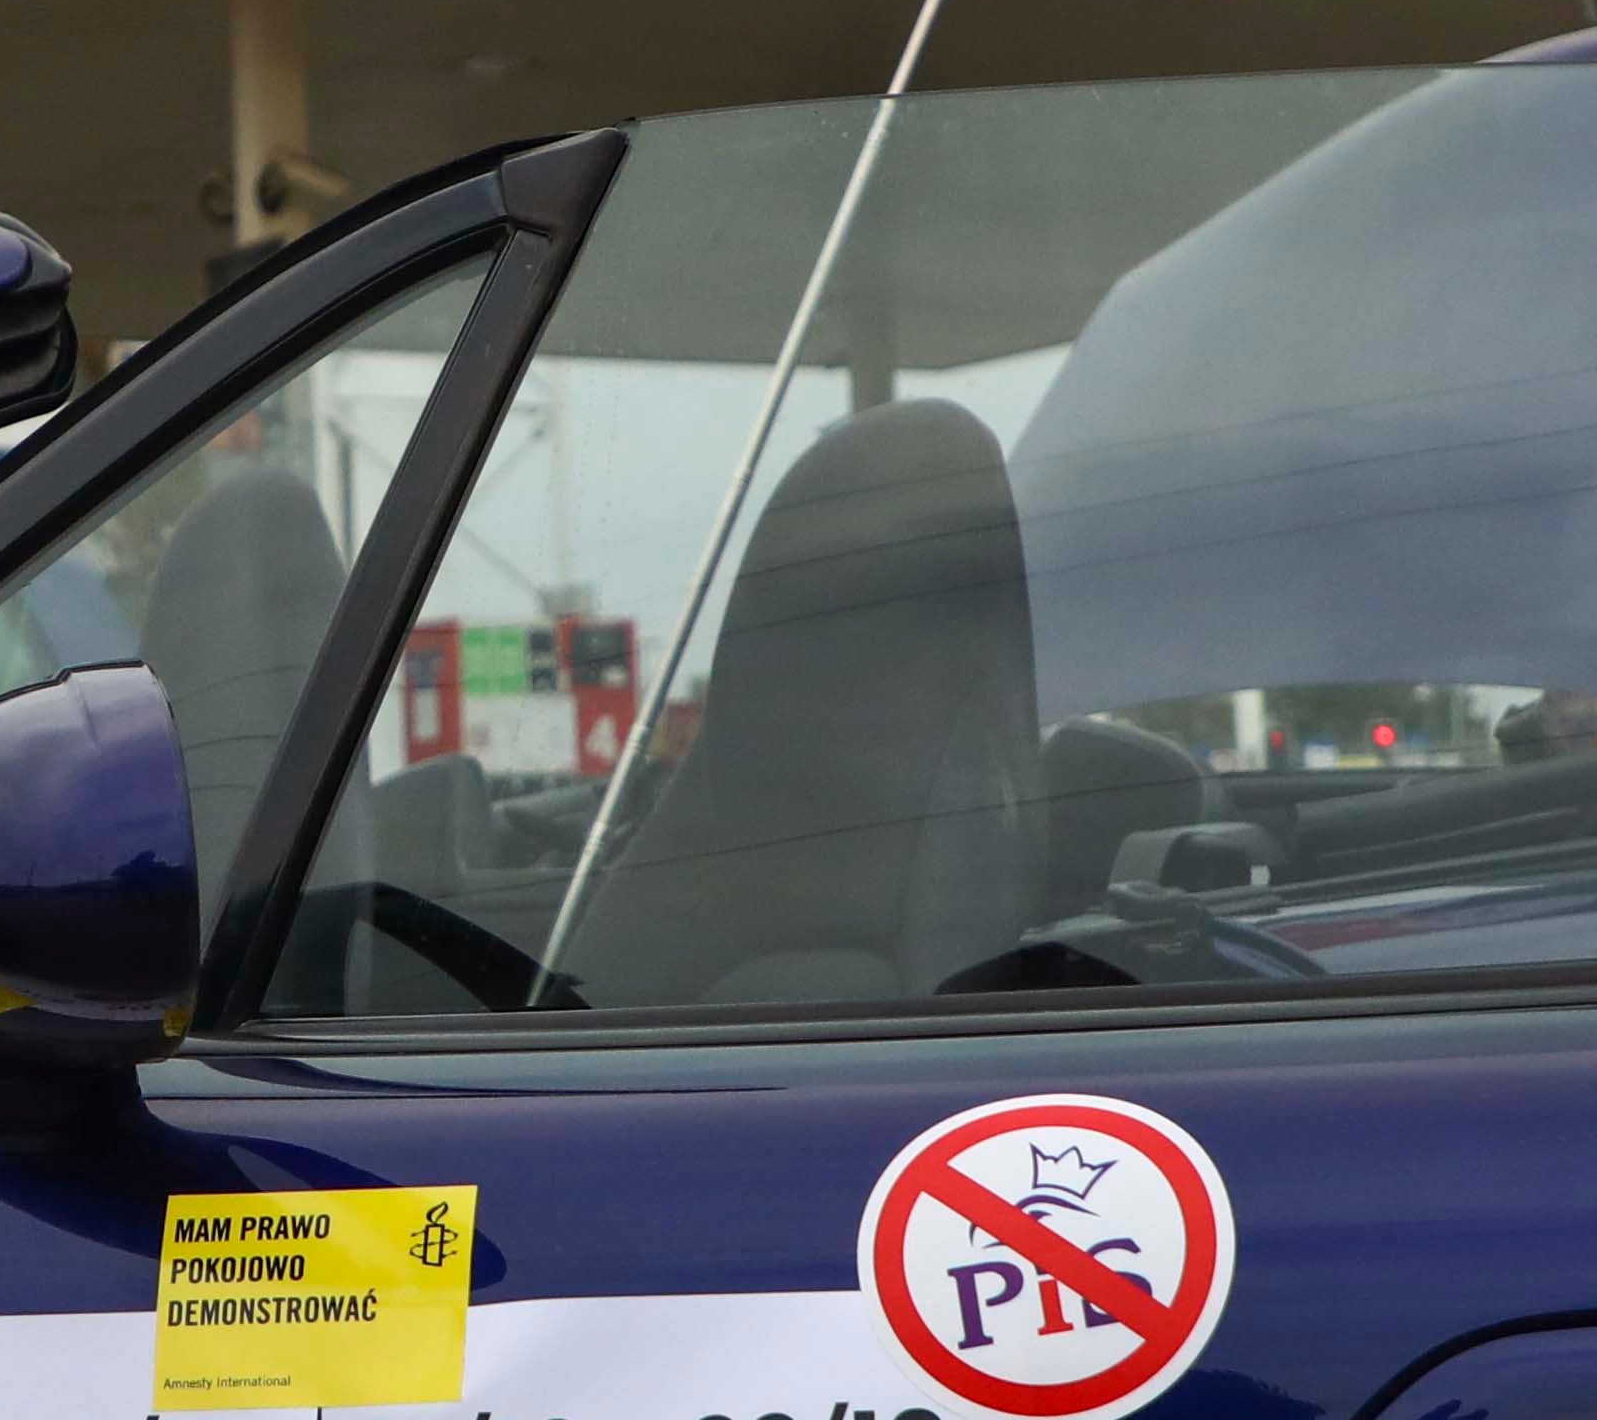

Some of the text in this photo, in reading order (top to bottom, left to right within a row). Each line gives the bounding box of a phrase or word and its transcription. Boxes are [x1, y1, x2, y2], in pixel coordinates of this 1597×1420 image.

[174, 1214, 331, 1244] MAM PRAWO
[170, 1254, 305, 1284] POKOJOWO
[167, 1288, 378, 1327] DEMONSTROWAĆ
[163, 1375, 291, 1390] Amnesty International
